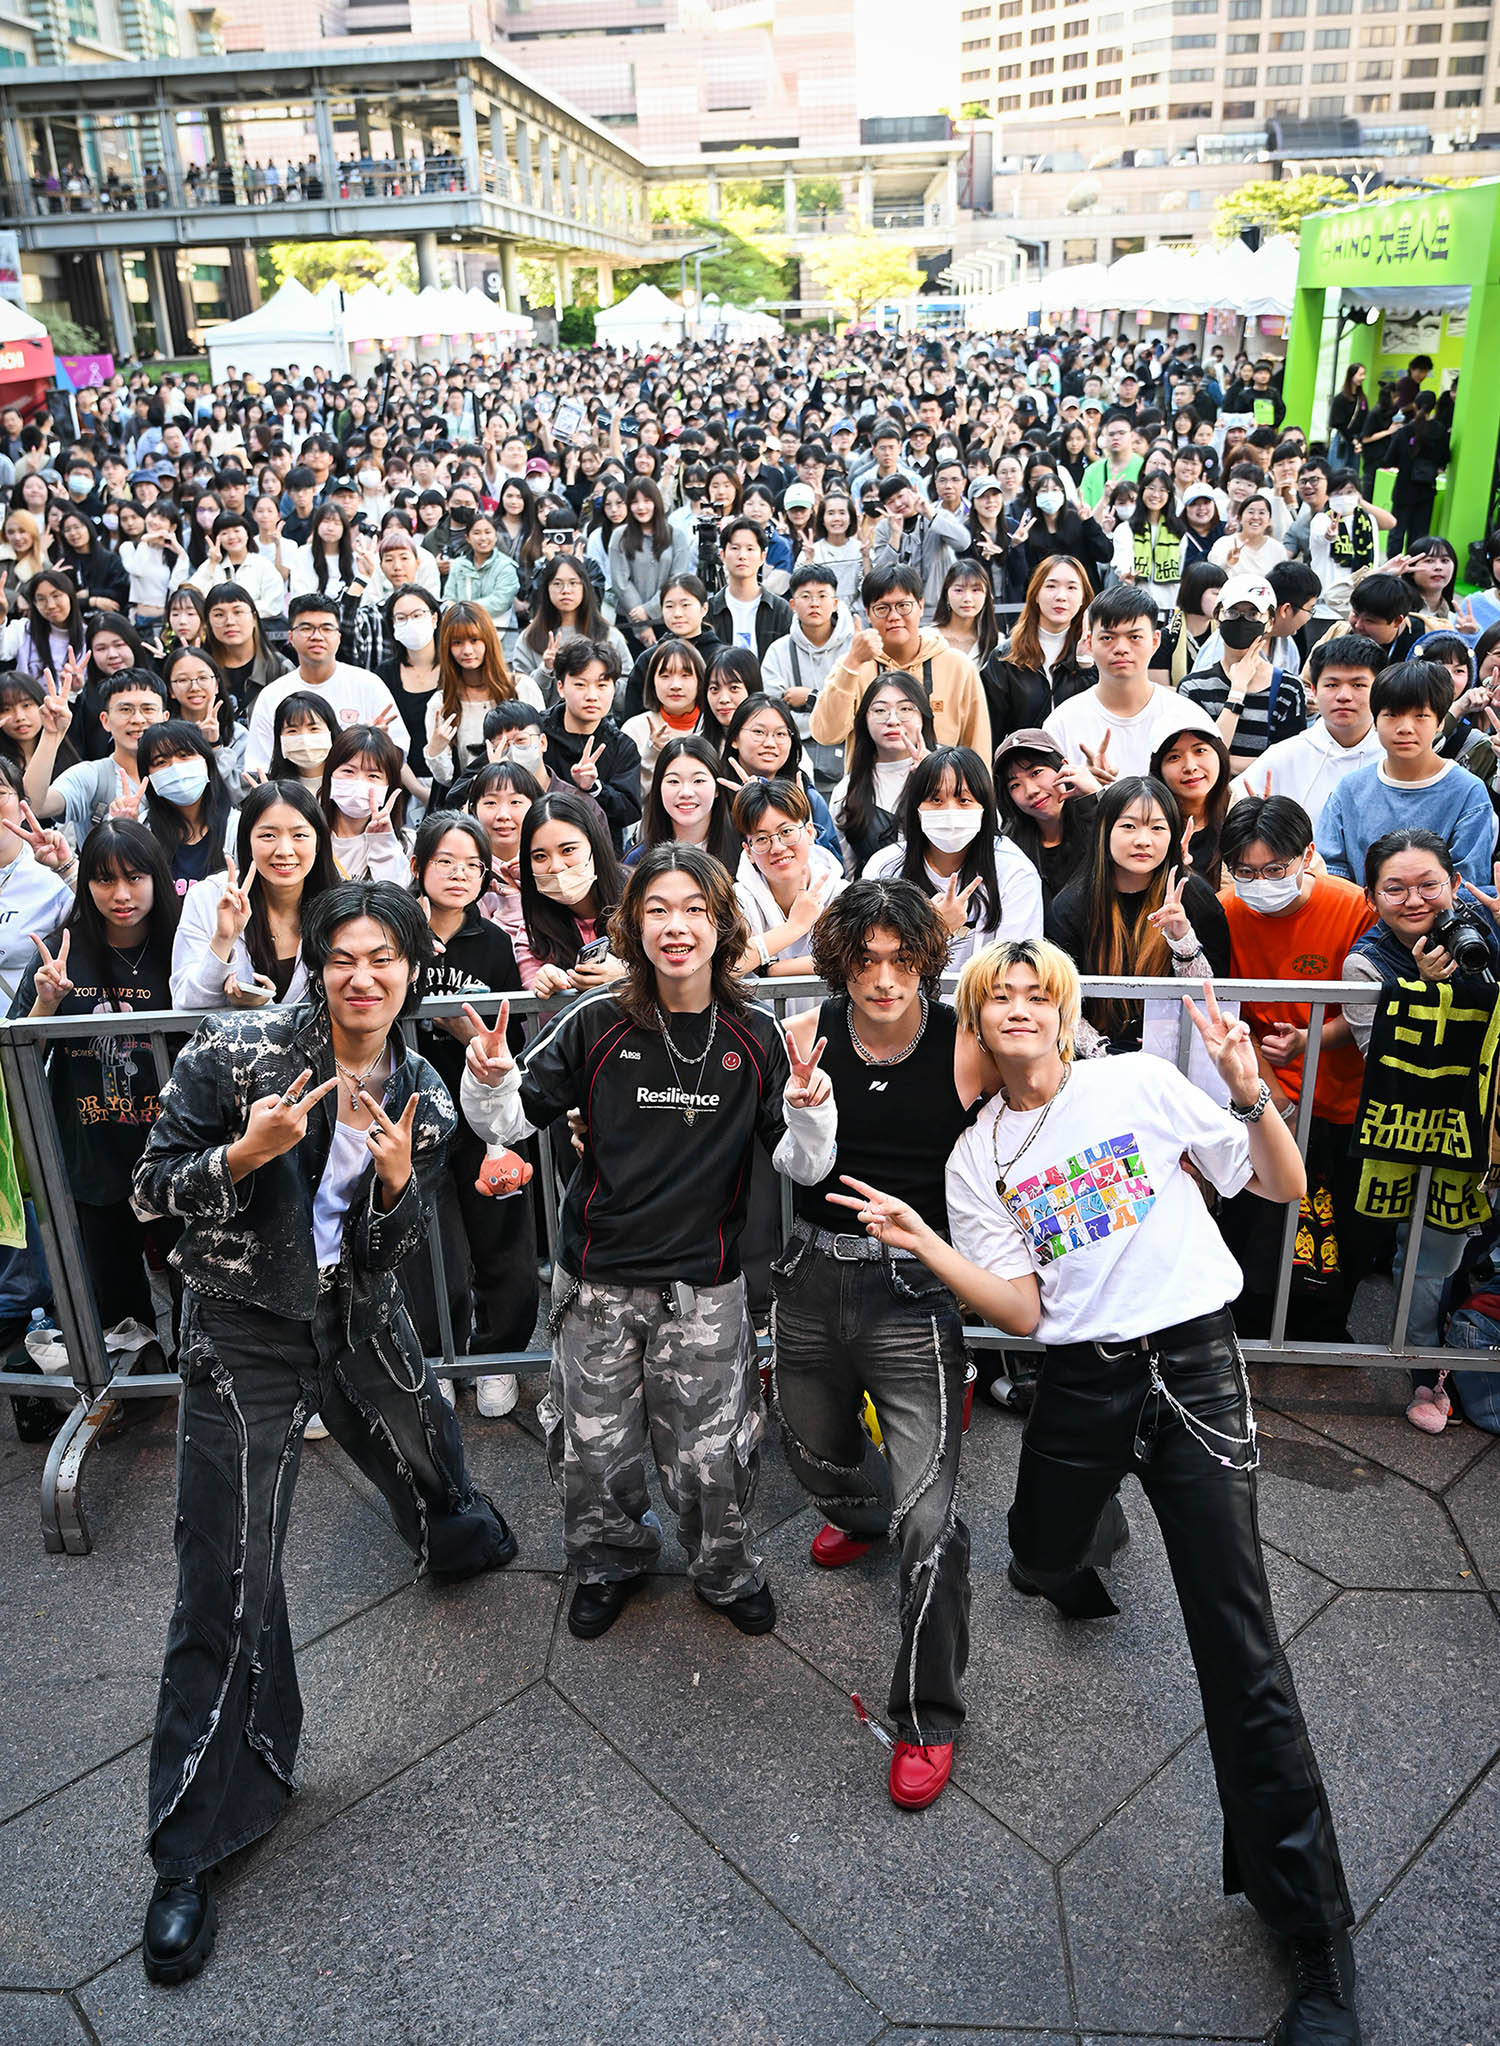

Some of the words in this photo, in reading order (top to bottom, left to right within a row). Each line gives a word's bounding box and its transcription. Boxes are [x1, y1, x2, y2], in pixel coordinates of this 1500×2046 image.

[73, 987, 97, 997] YOU
[136, 988, 151, 999] TO
[636, 1086, 720, 1106] Resilience
